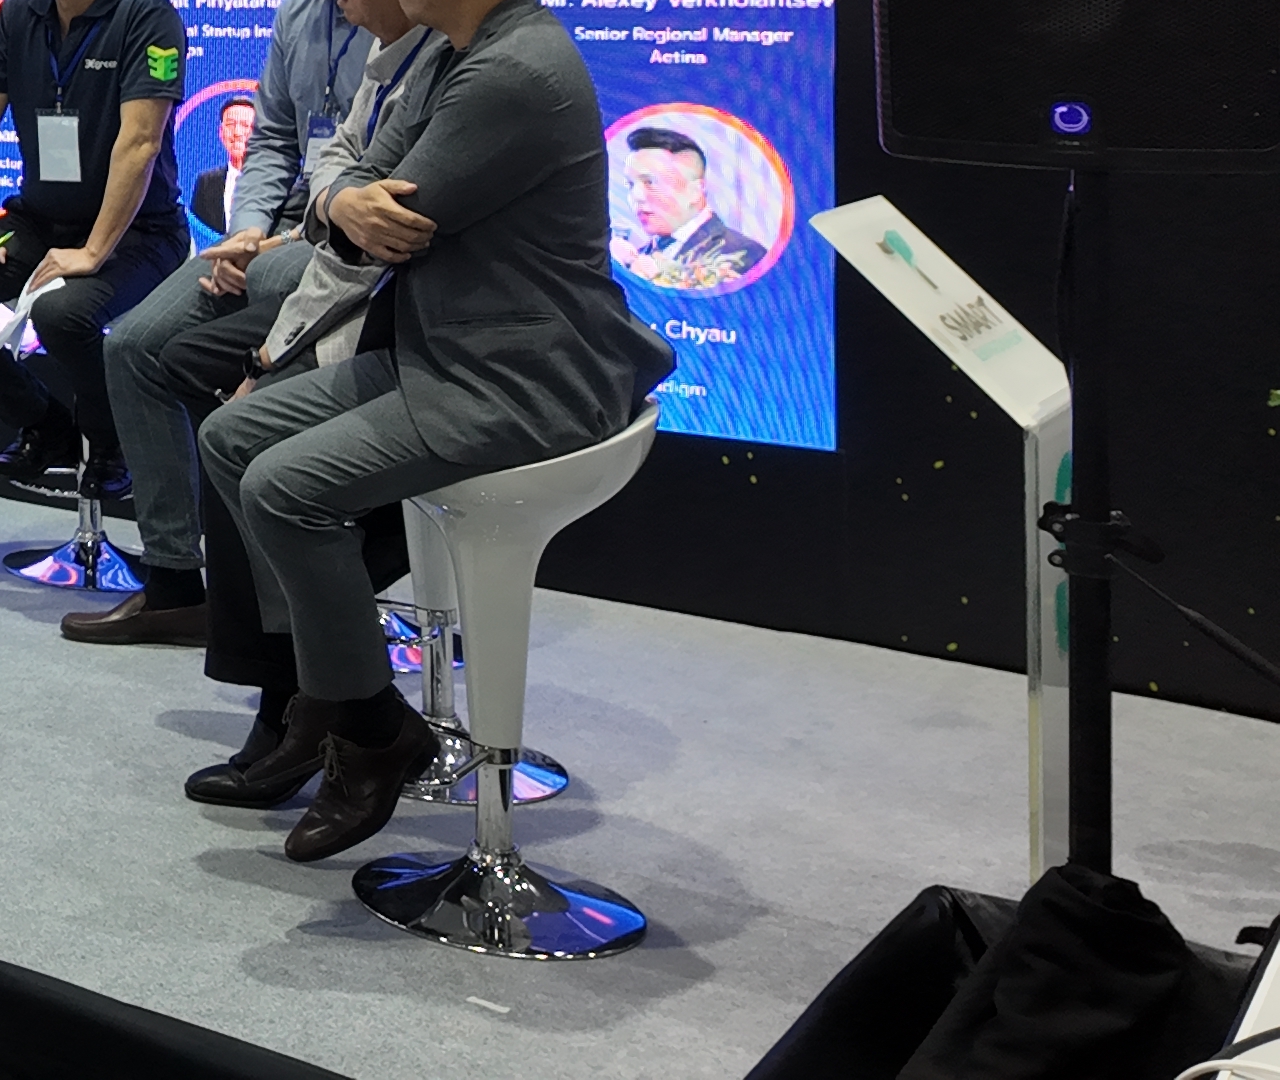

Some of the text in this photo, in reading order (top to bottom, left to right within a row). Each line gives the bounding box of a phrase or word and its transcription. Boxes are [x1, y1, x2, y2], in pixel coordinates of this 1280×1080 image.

[574, 26, 794, 45] Senior Regional Manager
[649, 48, 708, 65] Actina
[665, 319, 737, 345] Chyau
